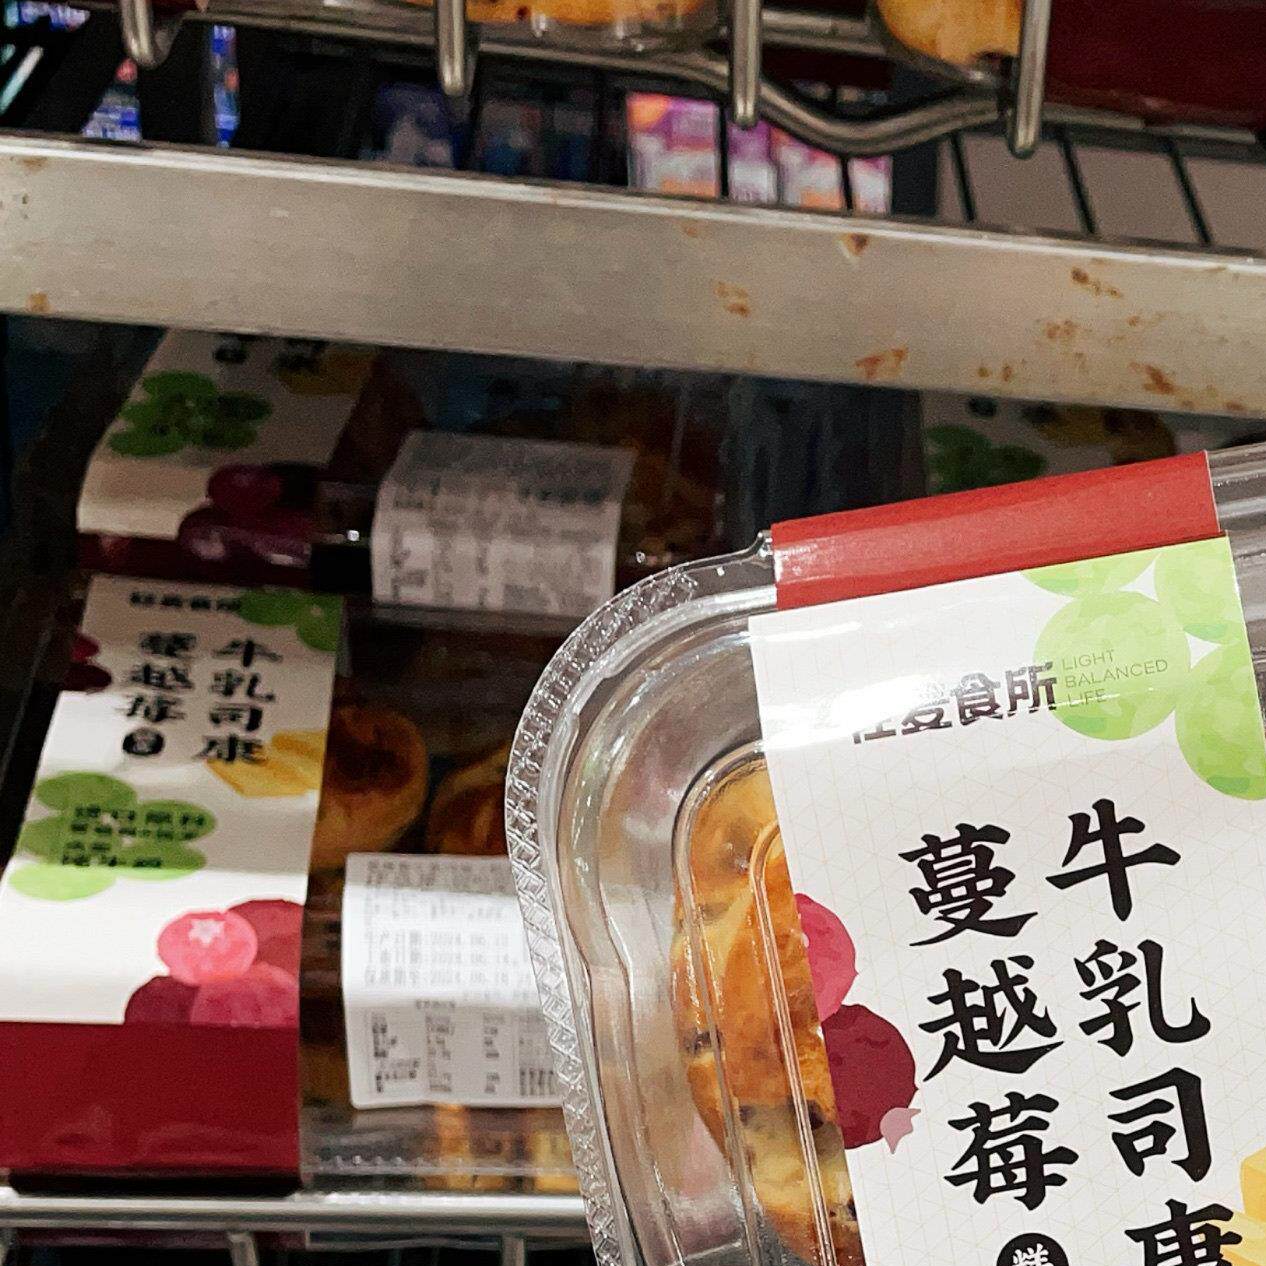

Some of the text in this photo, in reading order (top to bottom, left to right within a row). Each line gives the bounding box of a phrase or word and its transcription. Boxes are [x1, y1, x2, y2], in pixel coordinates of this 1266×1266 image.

[1063, 649, 1115, 671] LIGHT
[1065, 659, 1168, 688] BALANCED
[1066, 688, 1106, 708] LIFE
[899, 825, 1078, 1211] 蔓越莓
